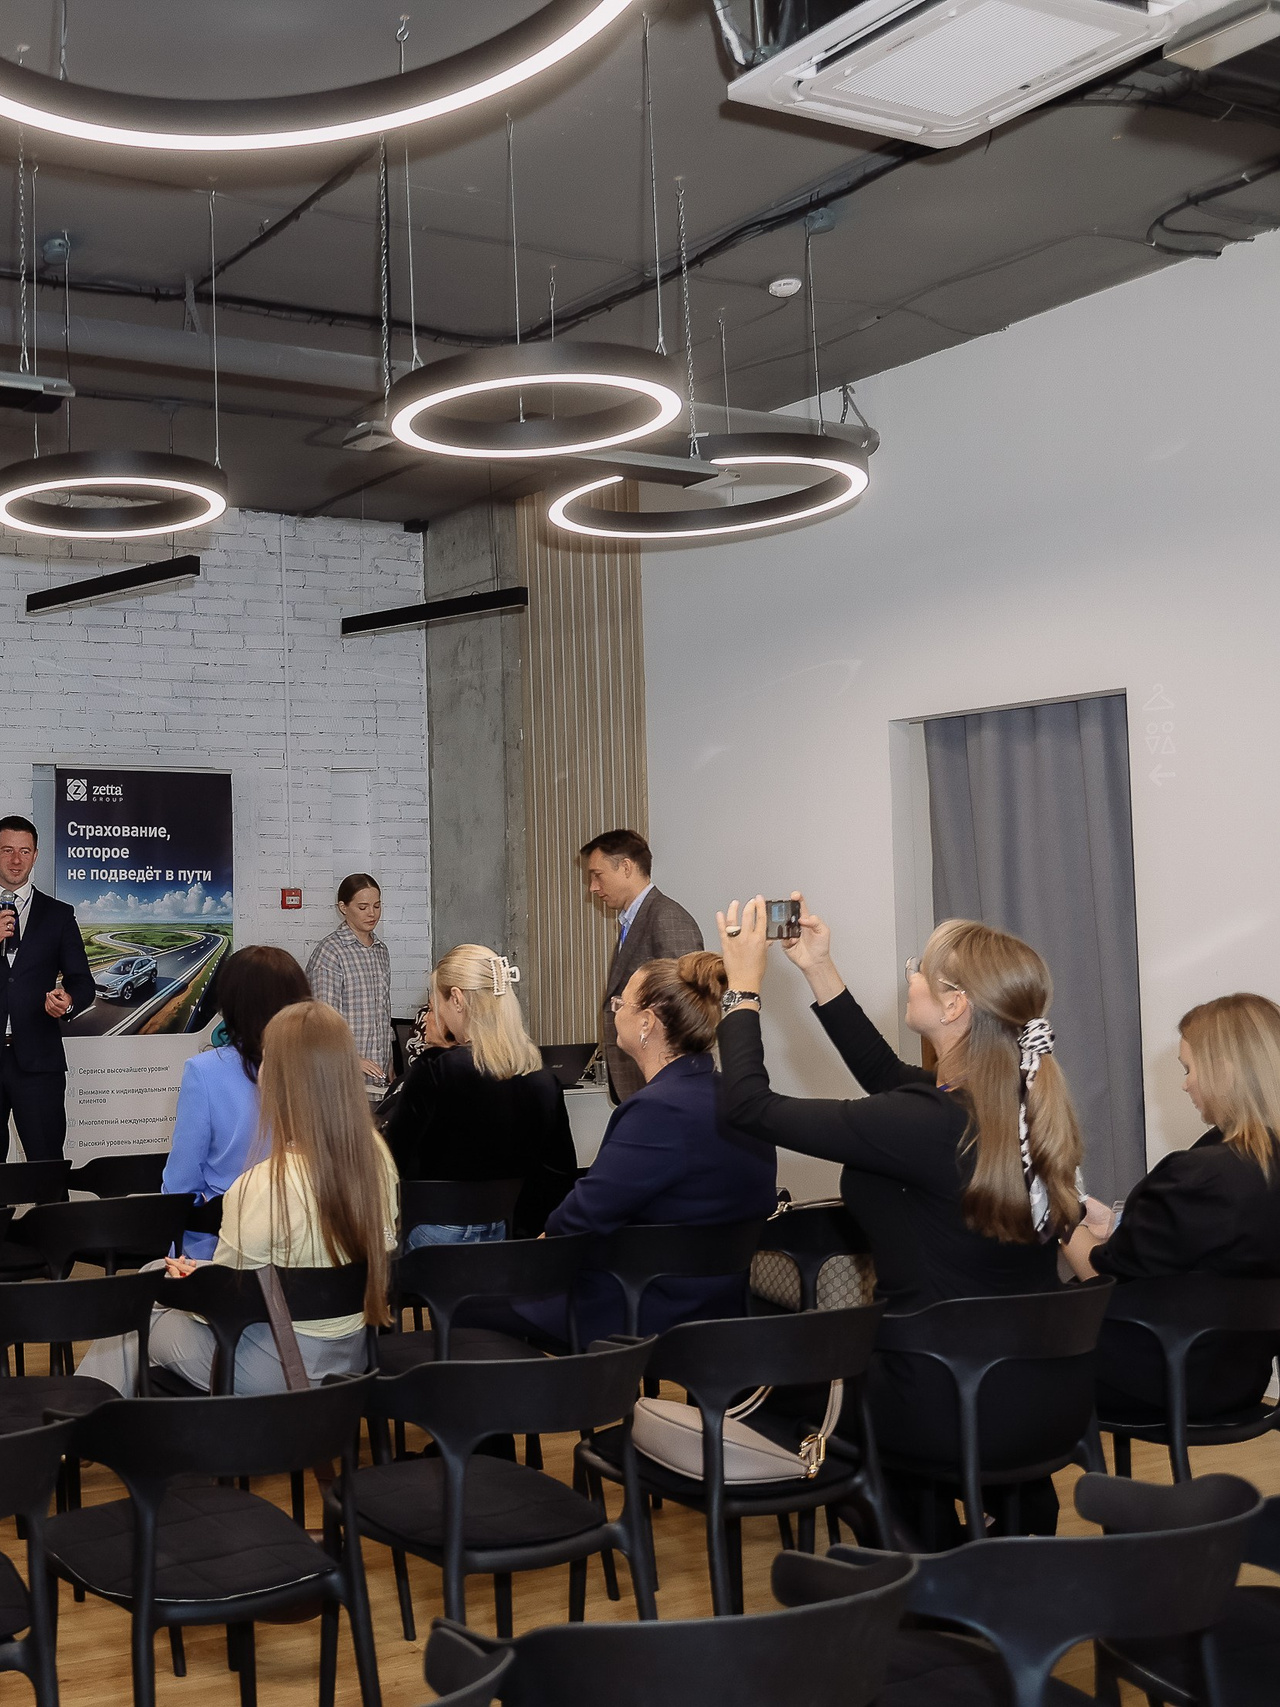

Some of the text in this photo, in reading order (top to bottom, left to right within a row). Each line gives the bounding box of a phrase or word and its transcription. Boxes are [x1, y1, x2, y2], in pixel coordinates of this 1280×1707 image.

[92, 784, 123, 796] zetta
[67, 821, 171, 841] Страхование,
[67, 846, 129, 862] которое
[67, 866, 212, 885] не подведёт в пути
[78, 1067, 106, 1076] Сервисы
[107, 1066, 147, 1074] высочайшего
[78, 1088, 110, 1096] Внимание
[116, 1086, 167, 1096] индивидуальным
[78, 1117, 119, 1126] Многолетний
[120, 1115, 168, 1126] международный
[78, 1139, 106, 1148] Высокий
[106, 1139, 132, 1148] уровень
